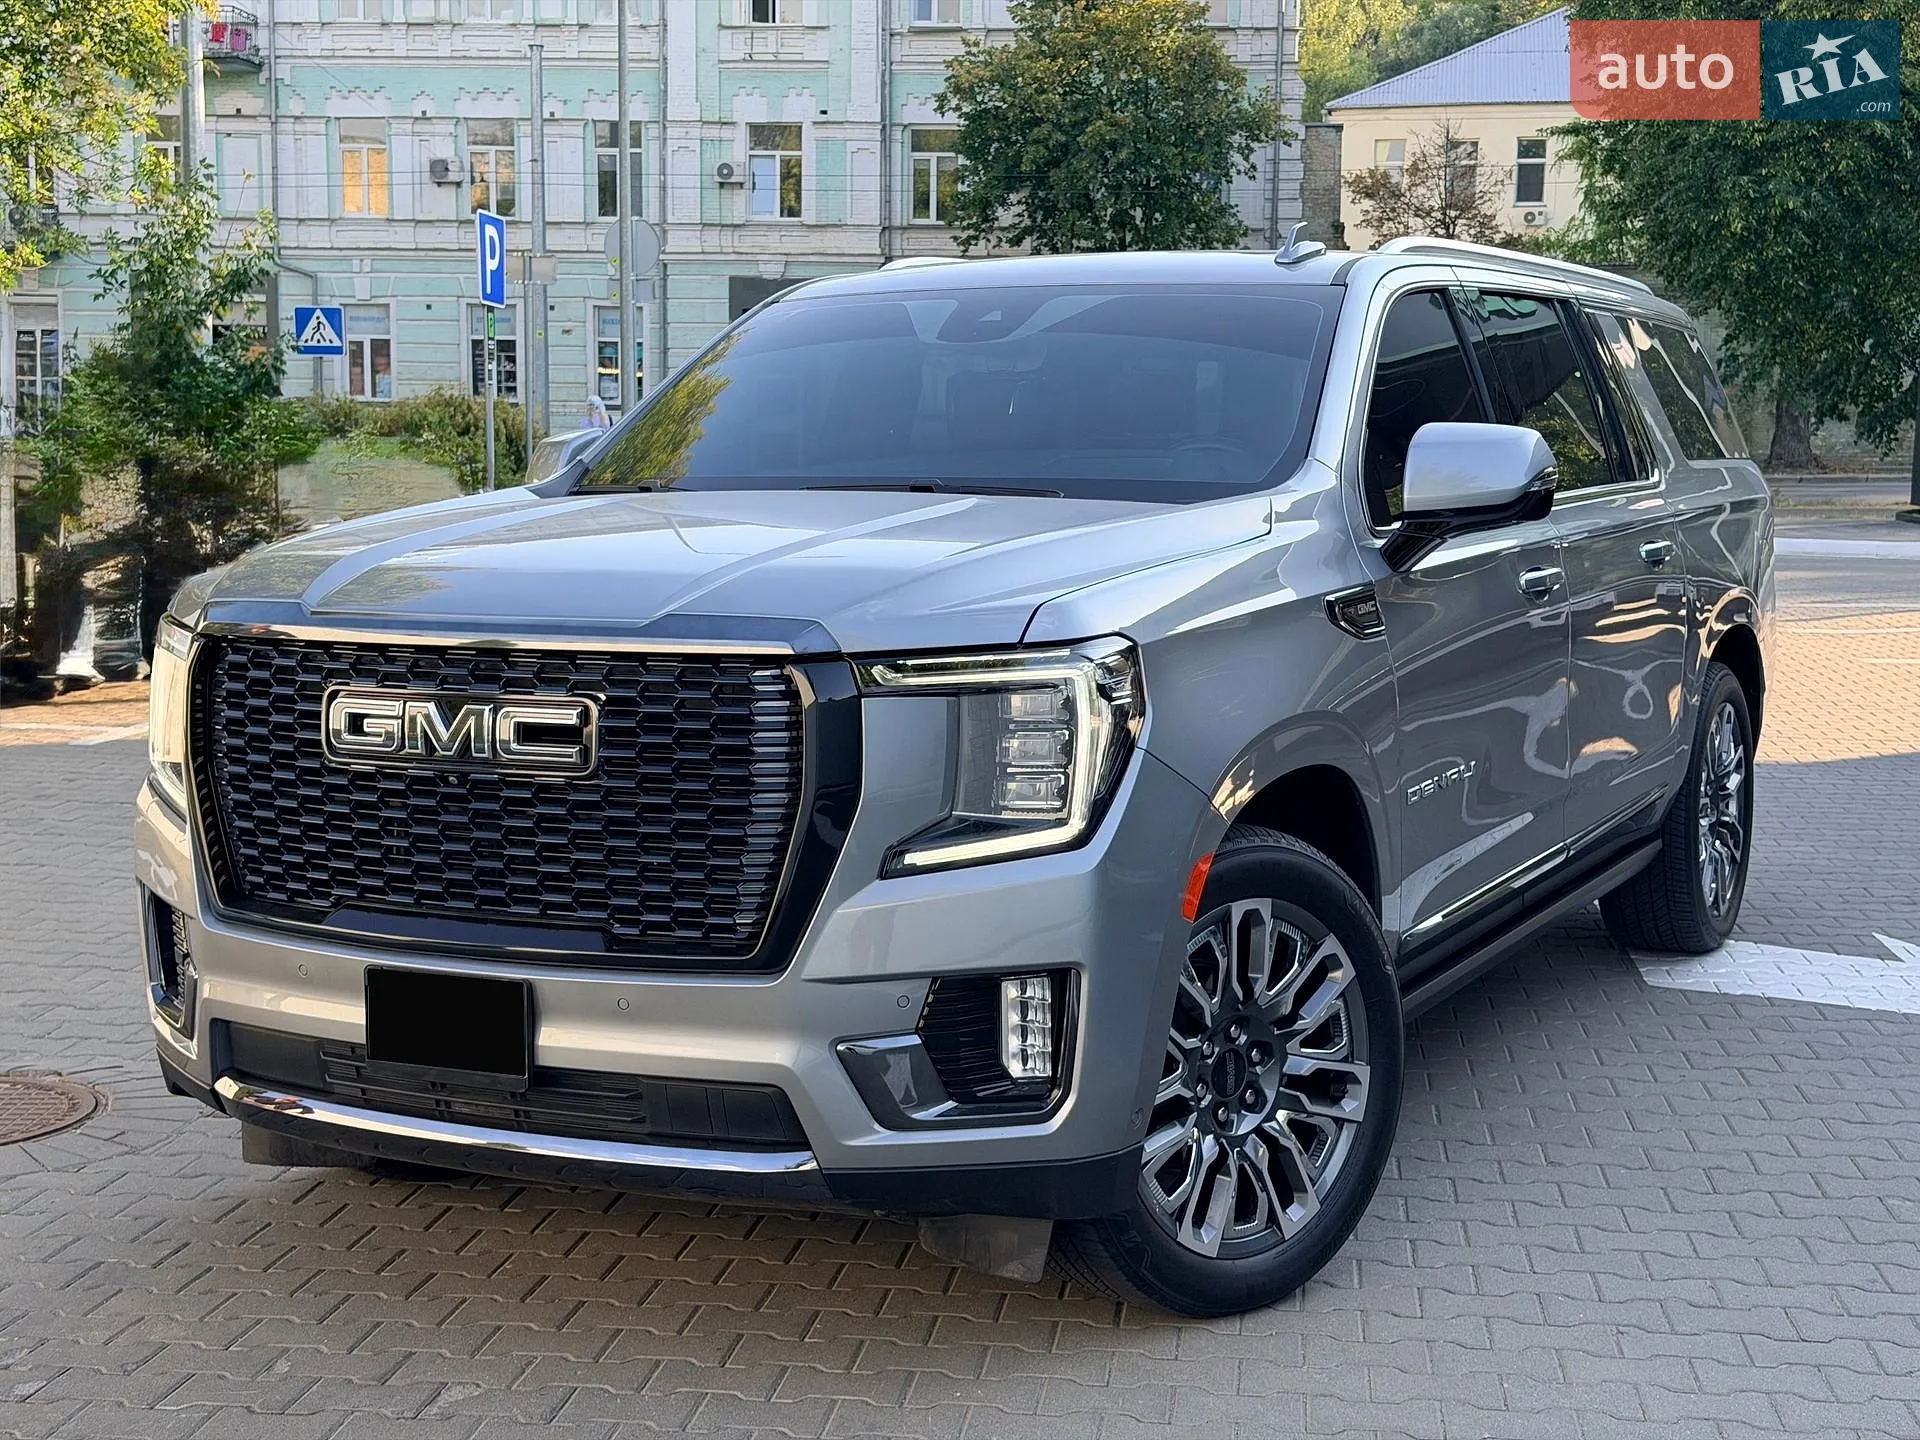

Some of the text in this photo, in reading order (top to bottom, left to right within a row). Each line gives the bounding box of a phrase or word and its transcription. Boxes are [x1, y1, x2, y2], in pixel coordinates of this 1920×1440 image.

[484, 223, 500, 295] P
[1357, 601, 1377, 615] GMC
[329, 697, 585, 765] GMC
